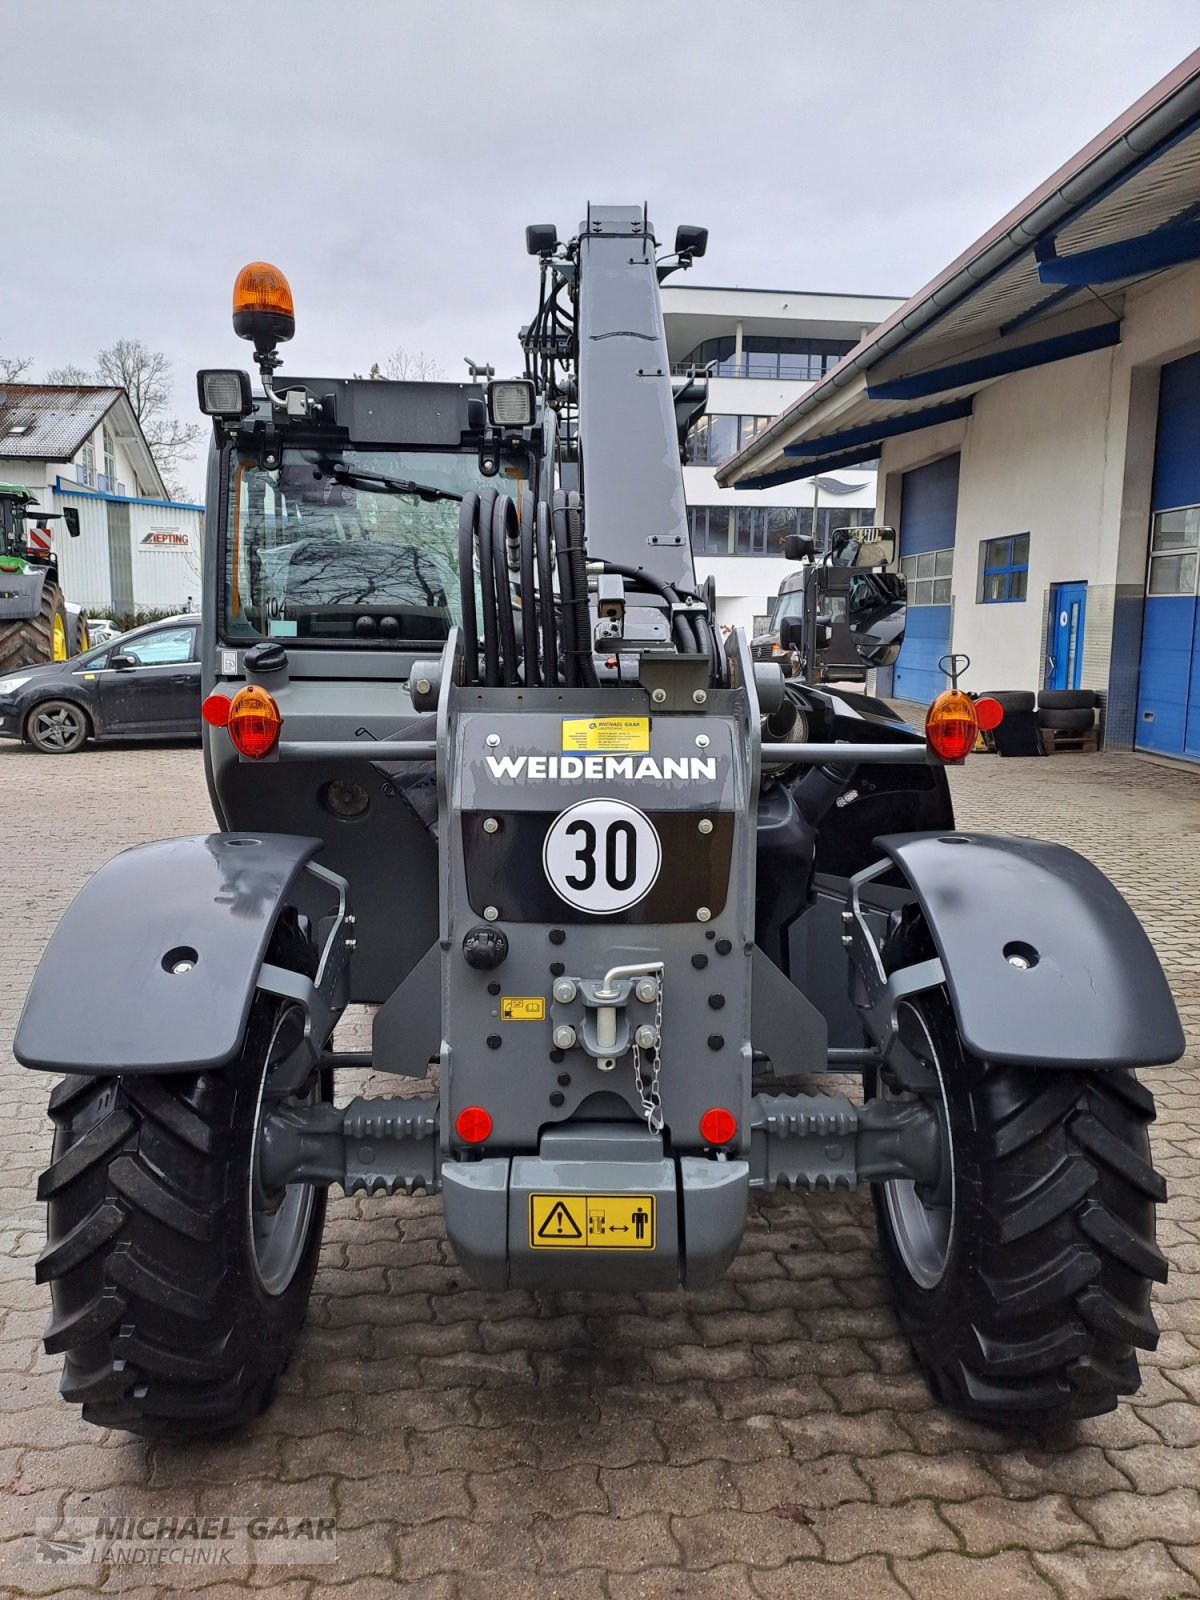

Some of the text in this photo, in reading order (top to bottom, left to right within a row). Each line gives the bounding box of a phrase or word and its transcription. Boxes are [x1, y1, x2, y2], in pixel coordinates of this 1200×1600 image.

[266, 597, 287, 617] 104
[486, 757, 716, 779] WEIDEMANN
[565, 819, 637, 891] 30
